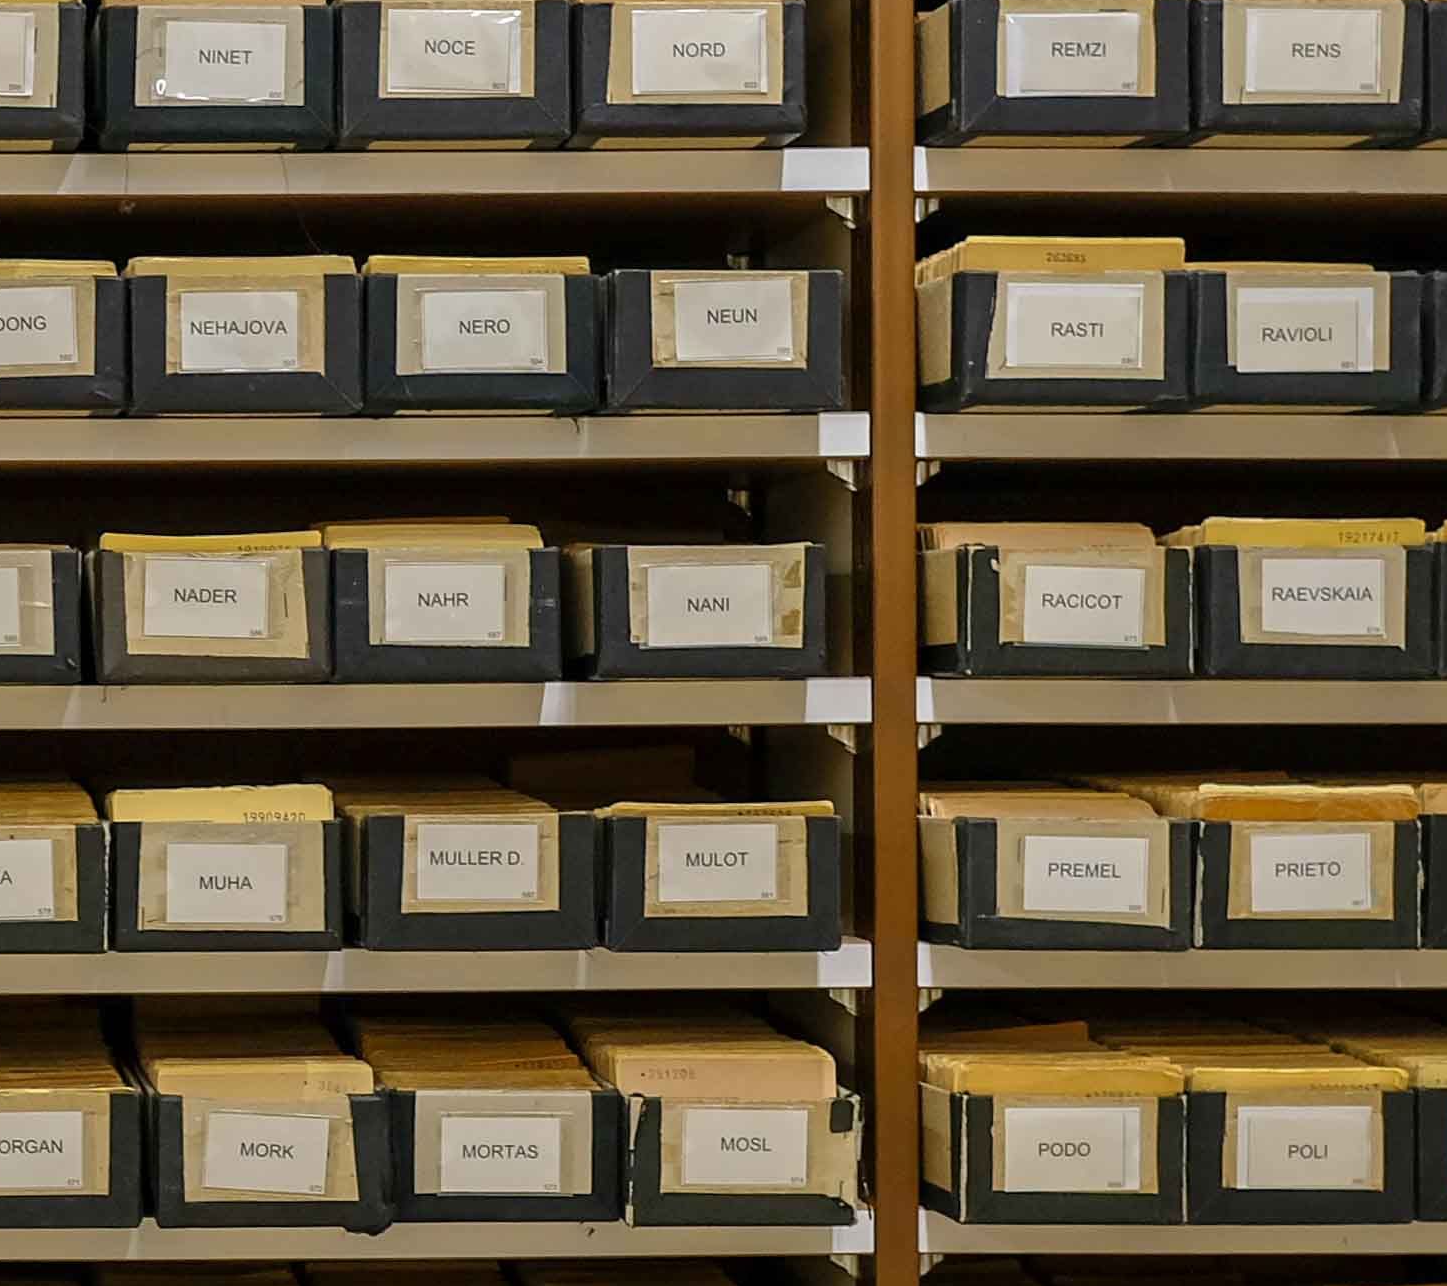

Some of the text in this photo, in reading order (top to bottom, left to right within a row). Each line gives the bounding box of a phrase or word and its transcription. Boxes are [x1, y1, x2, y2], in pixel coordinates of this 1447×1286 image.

[198, 48, 253, 65] NINET
[1051, 41, 1107, 58] REMZI
[706, 308, 758, 324] NEUN
[1050, 321, 1104, 338] RASTI
[174, 588, 238, 604] NADER
[1041, 593, 1123, 610] RACICOT
[687, 597, 730, 613] NANI
[1048, 862, 1122, 879] PREMEL
[199, 875, 253, 891] MUHA
[240, 1142, 294, 1159] MORK
[1038, 1141, 1091, 1158] PODO
